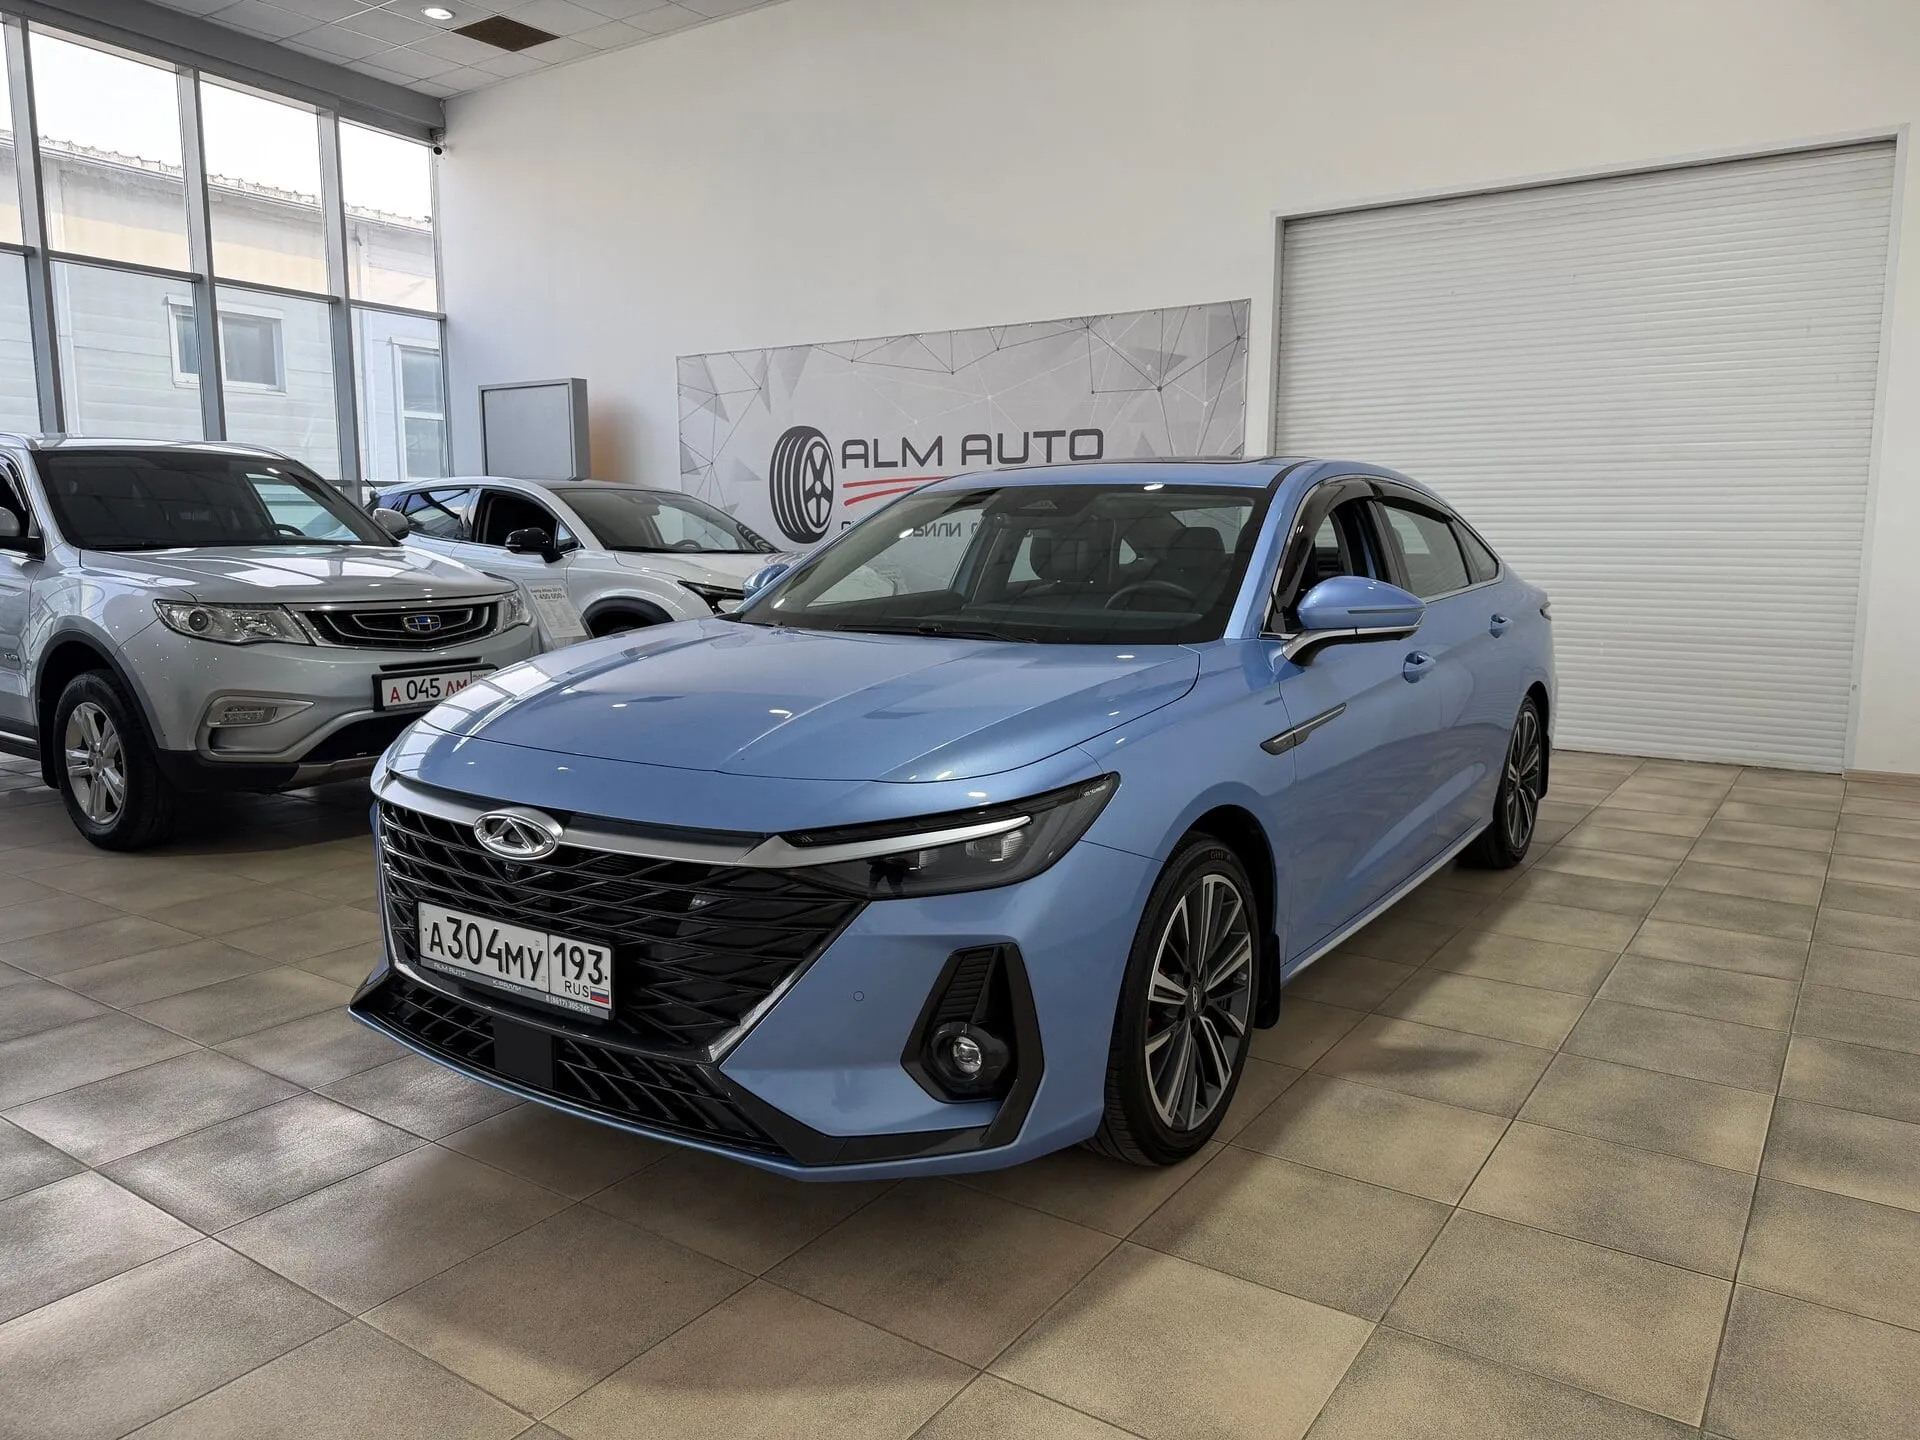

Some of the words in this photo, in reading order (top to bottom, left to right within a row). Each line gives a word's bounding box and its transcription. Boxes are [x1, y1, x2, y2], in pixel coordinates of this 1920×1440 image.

[842, 435, 943, 469] ALM
[961, 428, 1104, 466] AUTO
[406, 677, 441, 700] 045
[553, 942, 603, 985] 193
[564, 980, 589, 998] RUS
